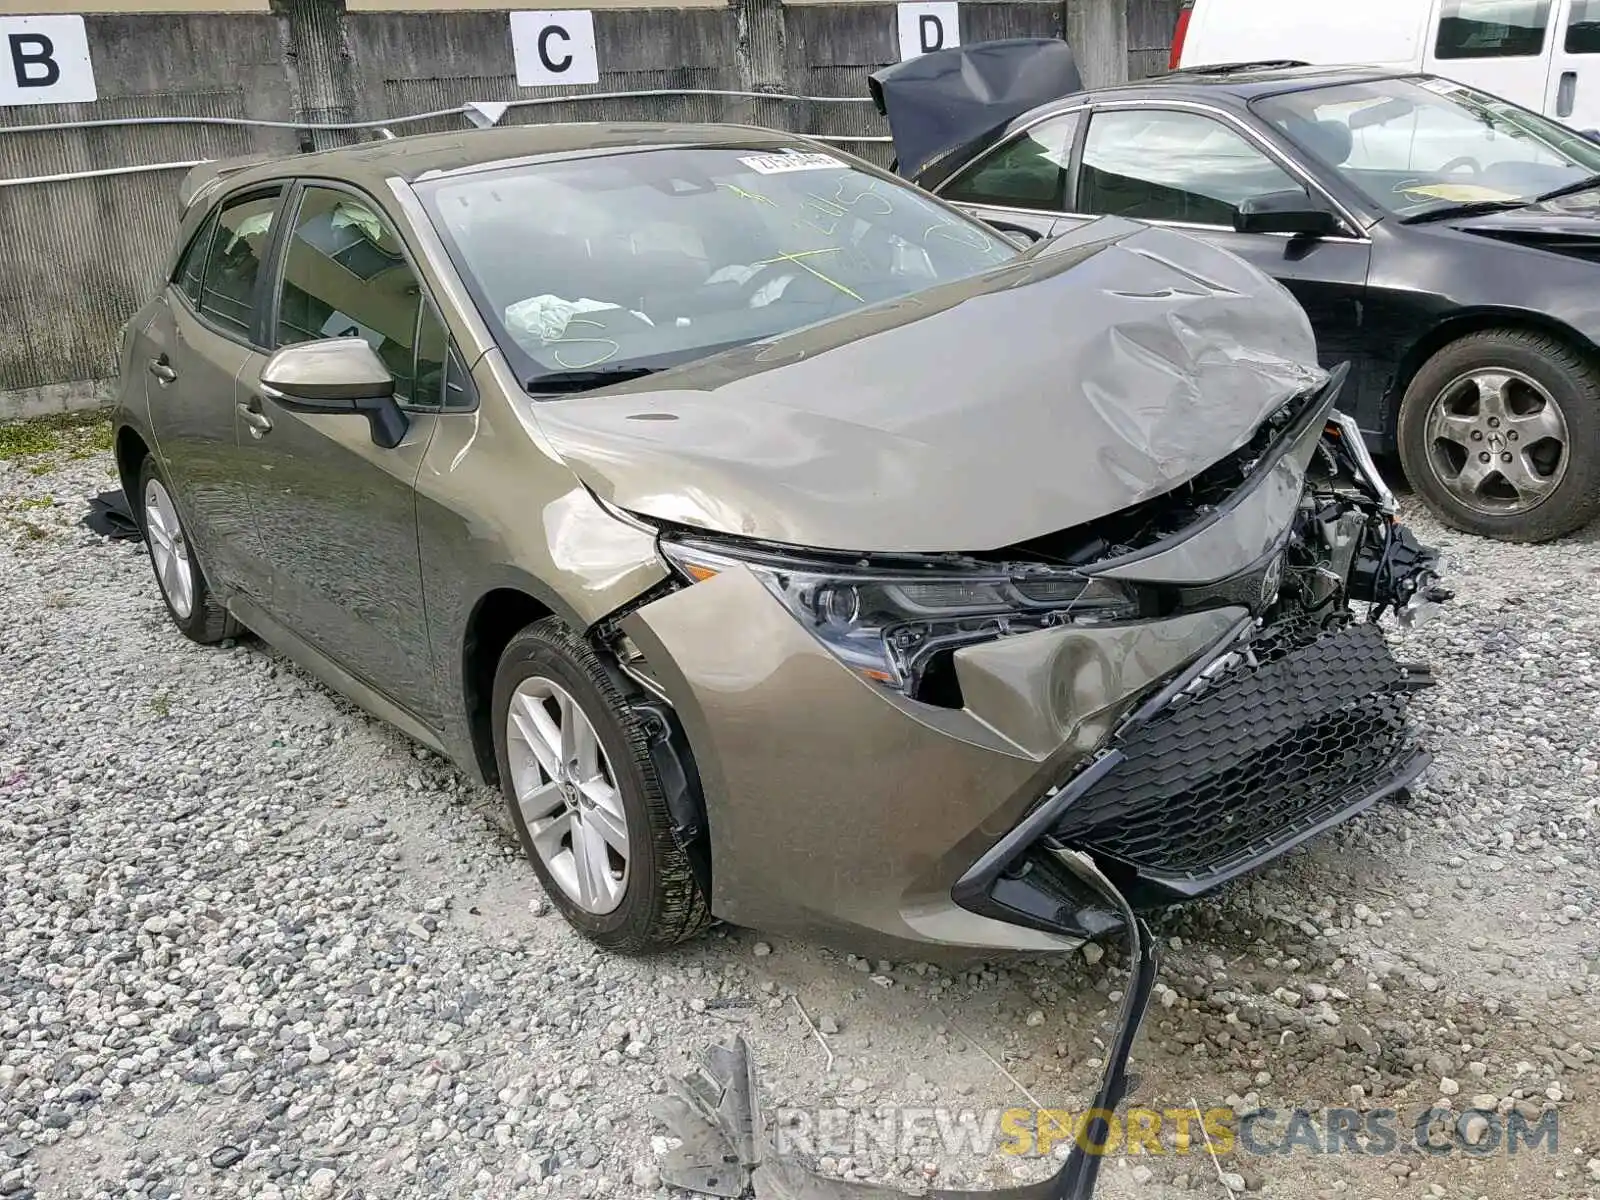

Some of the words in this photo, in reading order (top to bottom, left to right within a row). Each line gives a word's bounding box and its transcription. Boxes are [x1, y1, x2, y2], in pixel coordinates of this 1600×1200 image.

[538, 25, 573, 73] C
[919, 14, 944, 54] D
[8, 33, 60, 88] B
